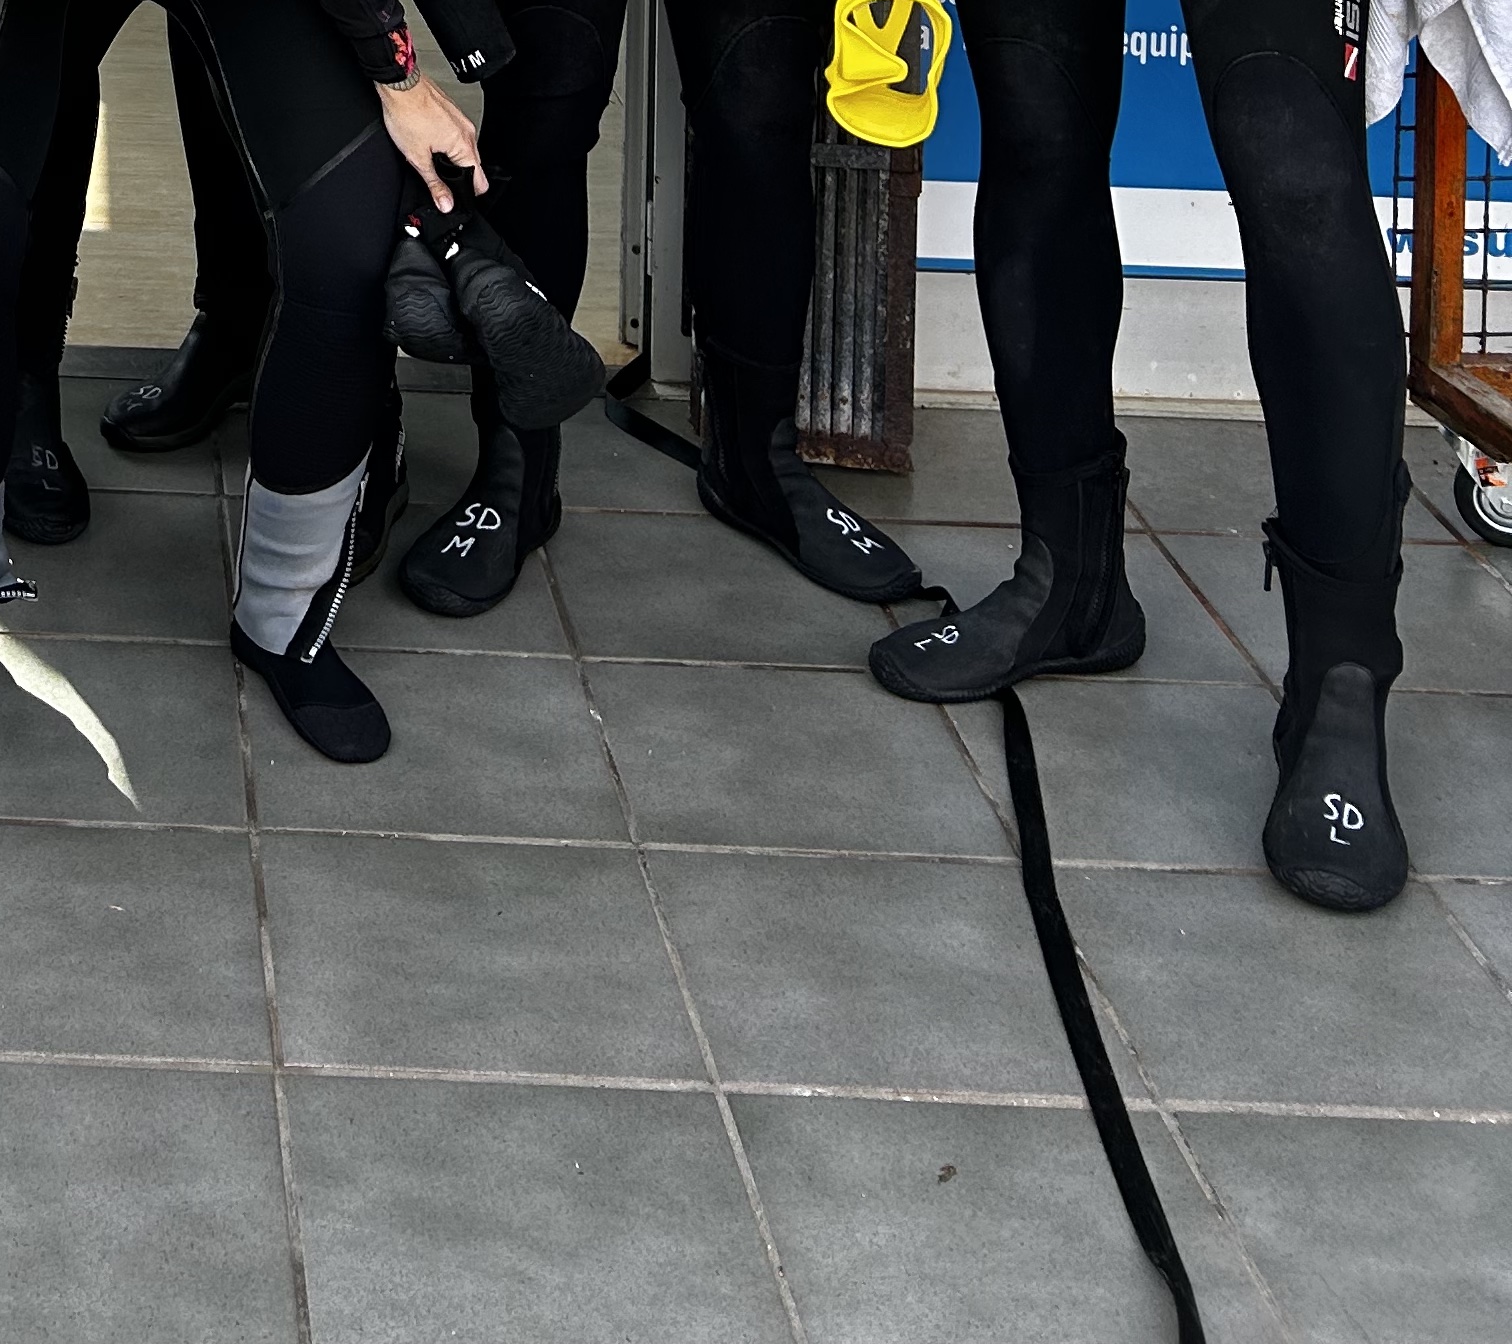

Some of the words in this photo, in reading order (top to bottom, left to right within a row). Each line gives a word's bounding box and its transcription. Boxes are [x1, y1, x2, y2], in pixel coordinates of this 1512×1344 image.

[455, 502, 502, 530] SD
[826, 508, 862, 535] SD
[440, 535, 476, 558] M
[850, 536, 885, 555] M
[913, 638, 933, 652] L
[930, 625, 959, 645] SD
[1323, 793, 1365, 830] SD
[1330, 825, 1351, 846] L
